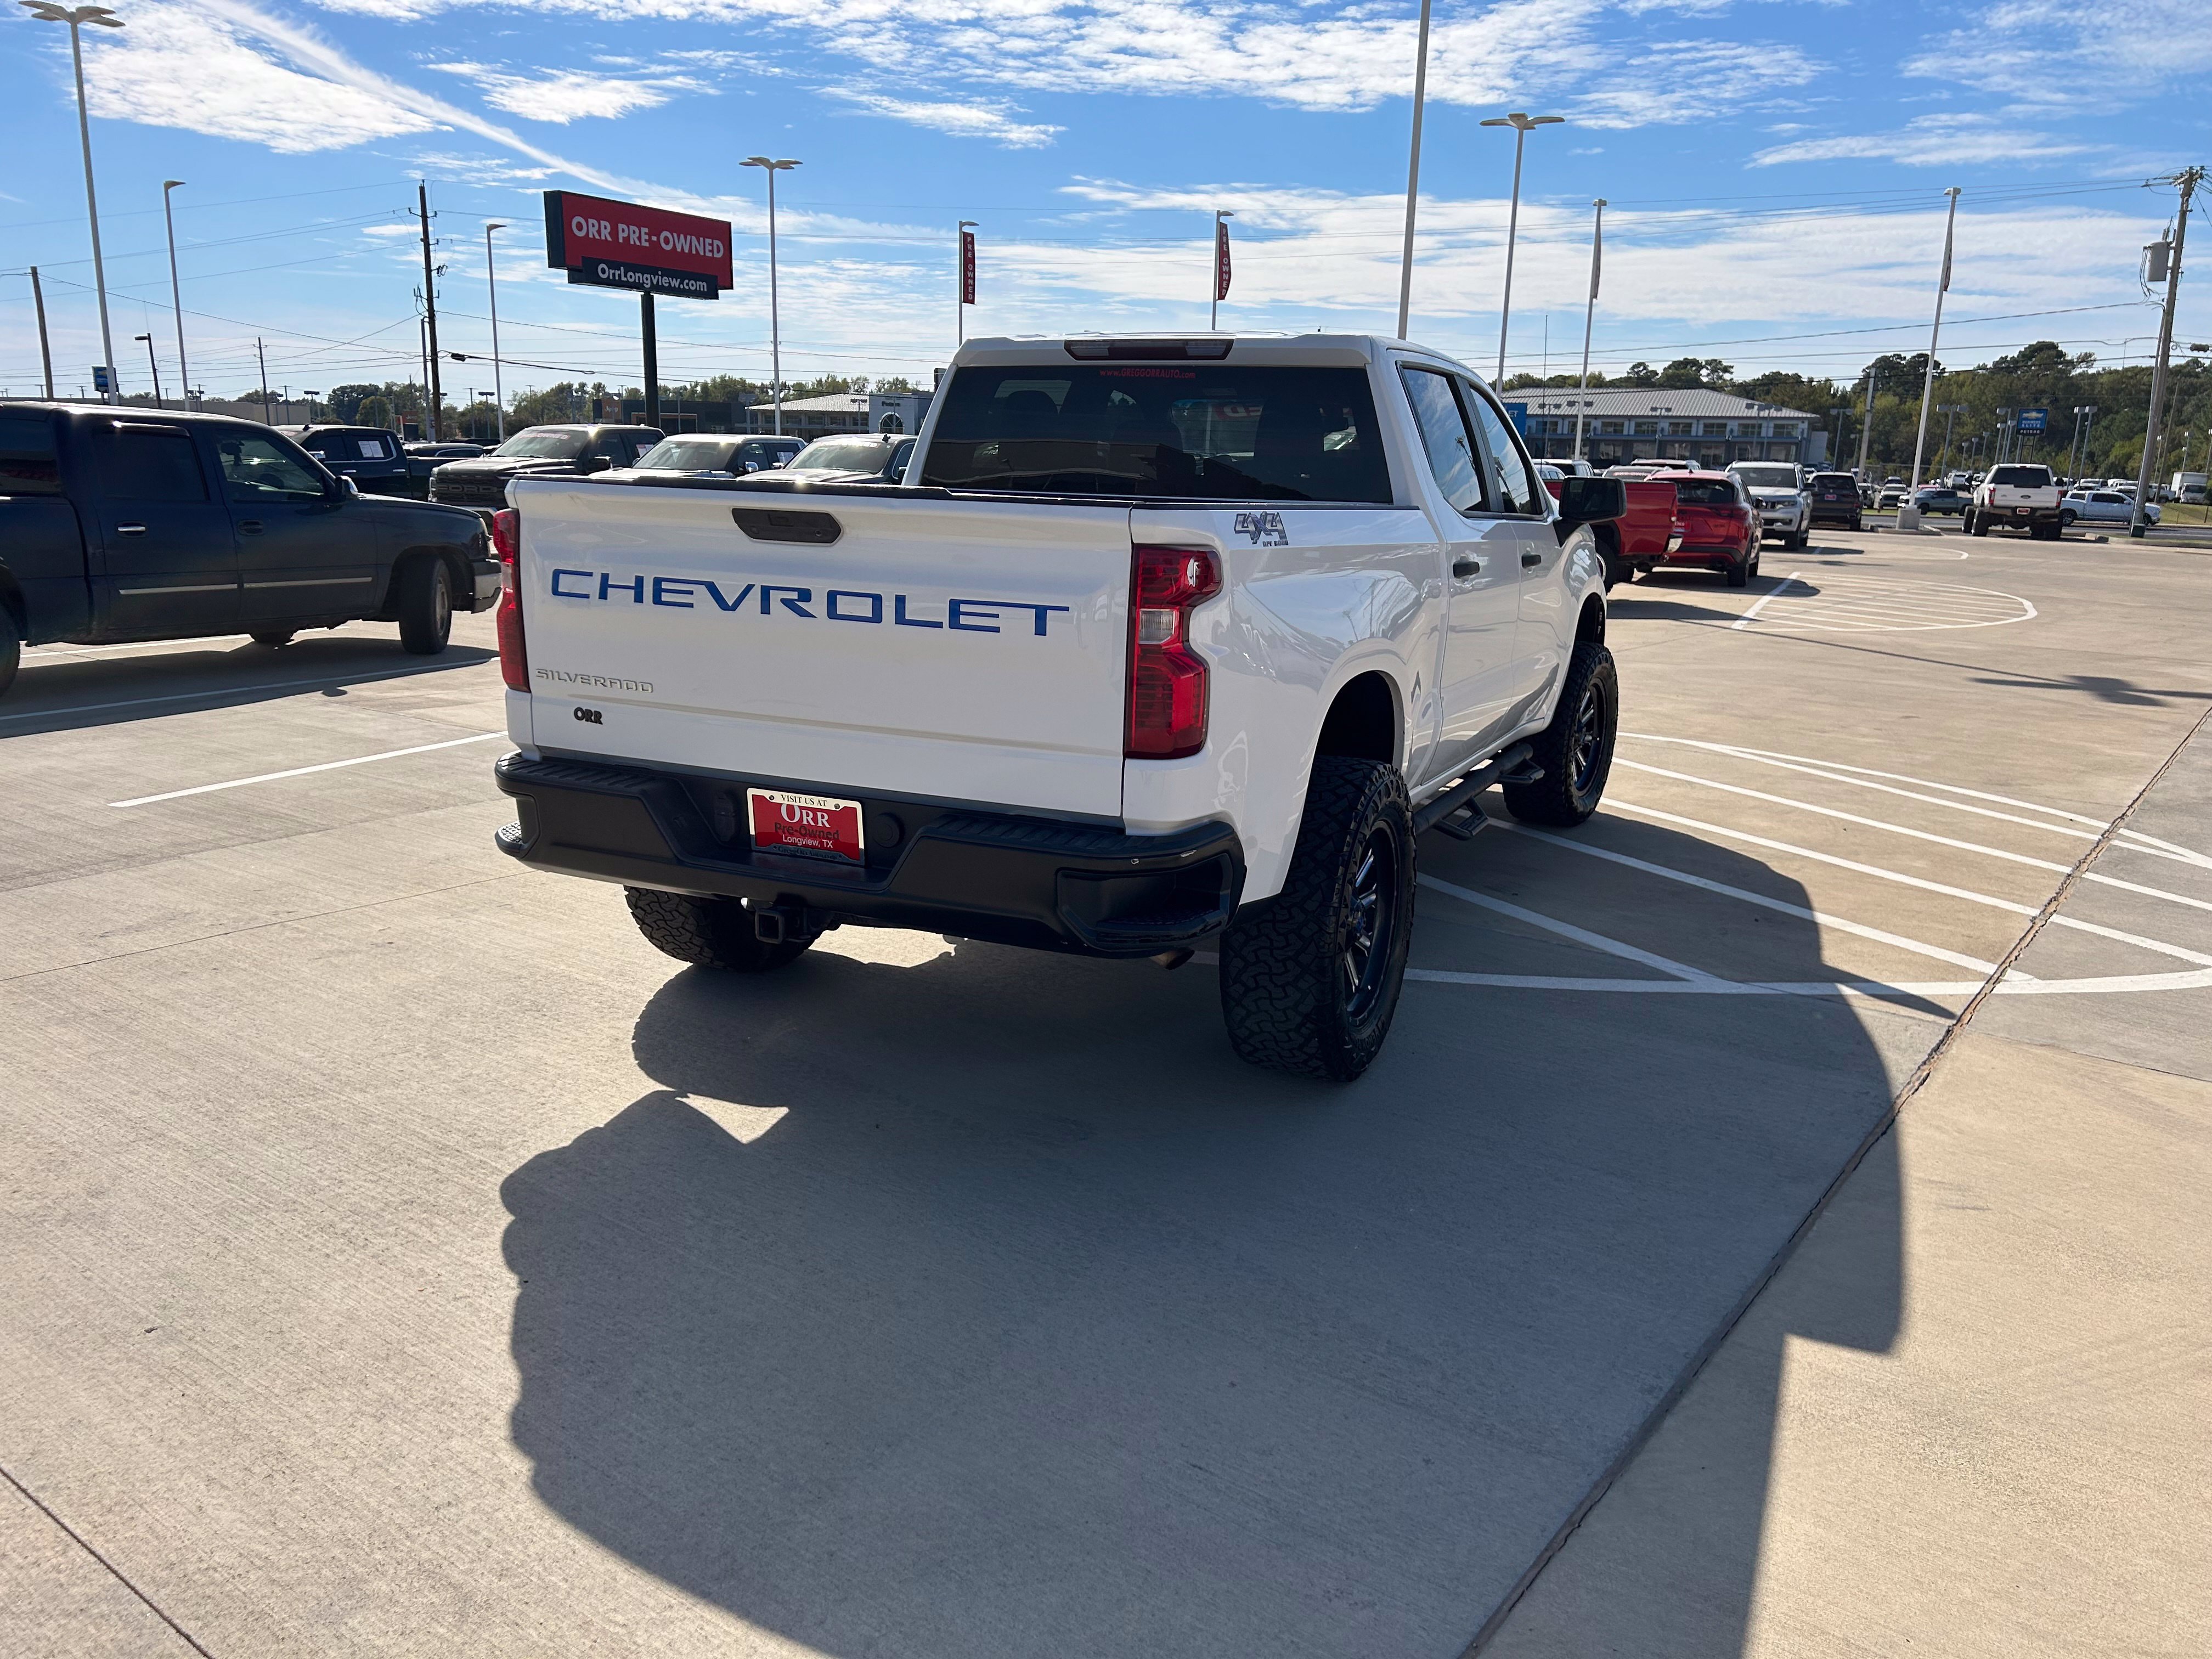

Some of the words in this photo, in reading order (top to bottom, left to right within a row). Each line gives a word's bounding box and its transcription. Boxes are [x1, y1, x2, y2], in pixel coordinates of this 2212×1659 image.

[571, 216, 612, 241] ORR
[597, 263, 708, 292] OrrLongview.com
[1099, 368, 1196, 379] www.GREGGORRAUTO.com
[551, 568, 1070, 636] CHEVROLET
[535, 668, 654, 693] SILVERADO
[573, 706, 603, 725] ORR
[781, 794, 803, 804] VISIT
[774, 822, 840, 840] Pre-Owned
[782, 834, 821, 847] Longview,
[822, 839, 834, 849] TX
